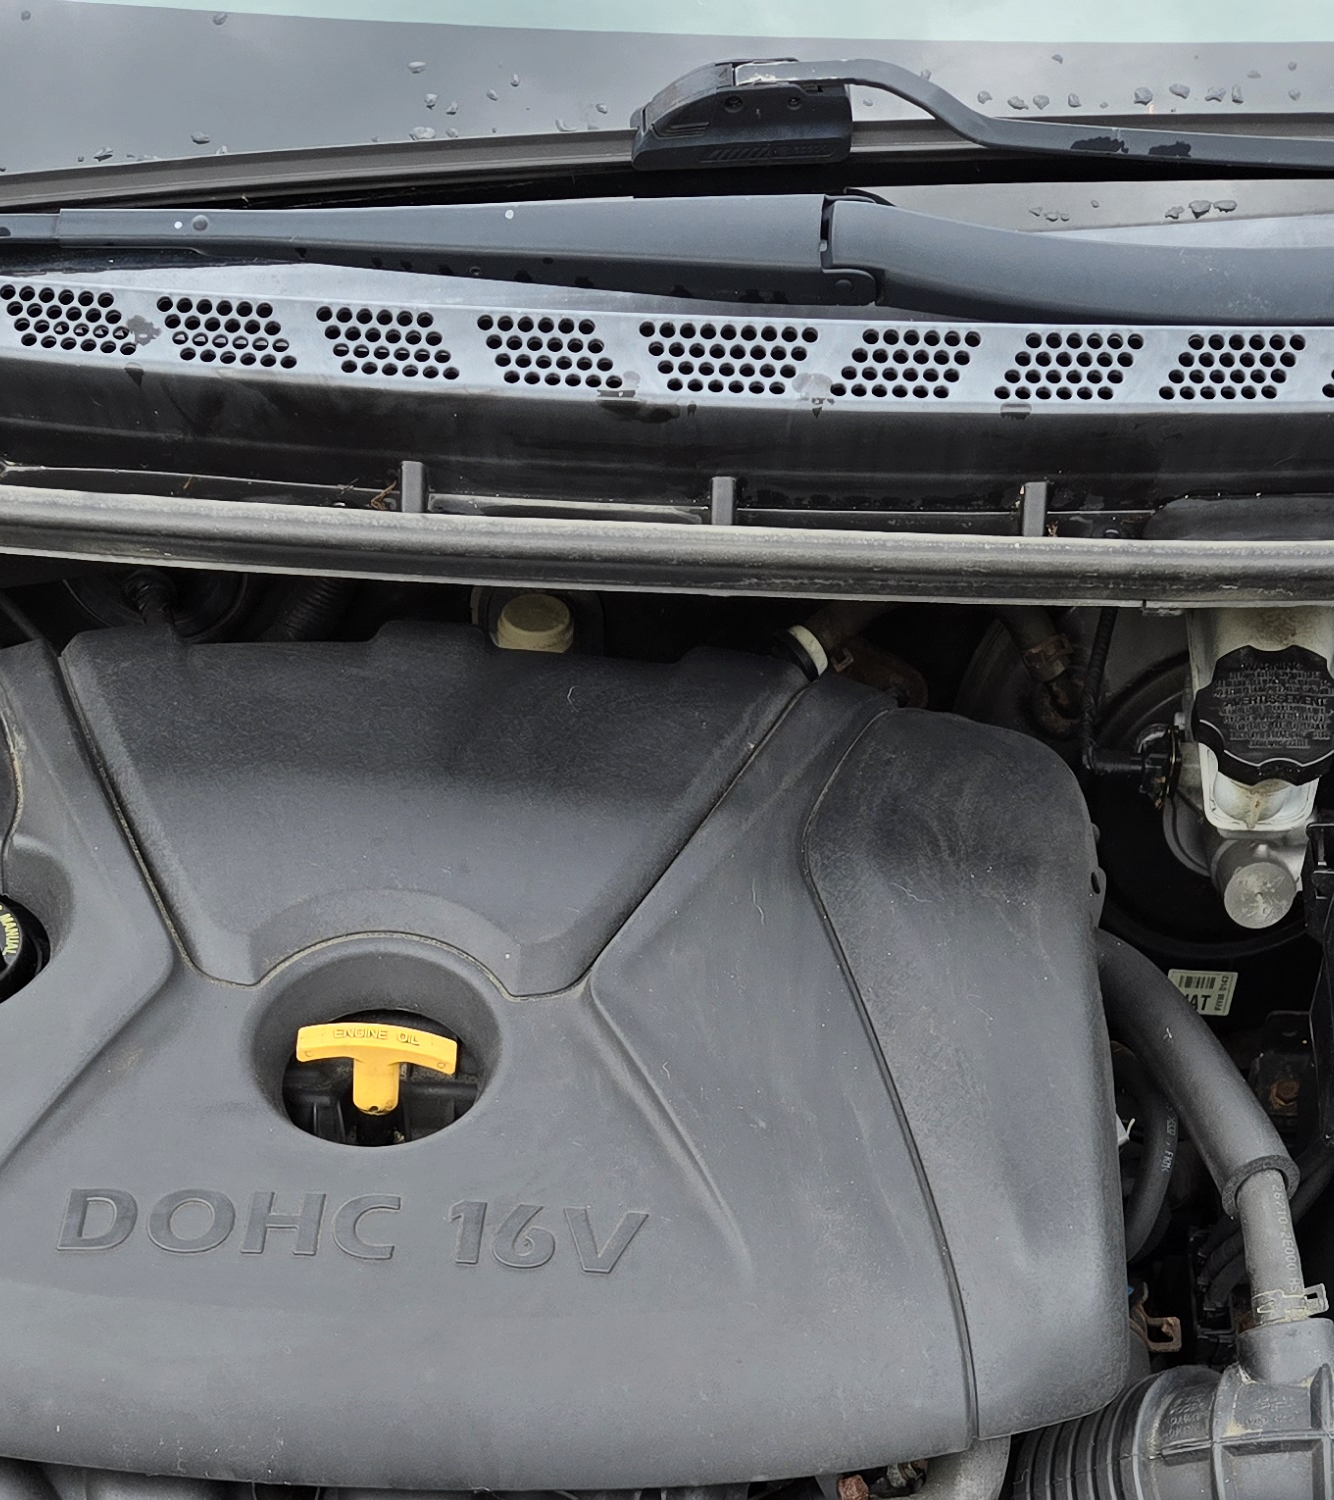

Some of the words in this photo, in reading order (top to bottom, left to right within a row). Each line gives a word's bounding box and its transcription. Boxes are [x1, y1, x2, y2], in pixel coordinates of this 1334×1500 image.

[333, 1028, 388, 1040] ENGINE
[396, 1032, 420, 1046] OIL
[56, 1188, 403, 1261] DOHC
[448, 1199, 650, 1275] 16V
